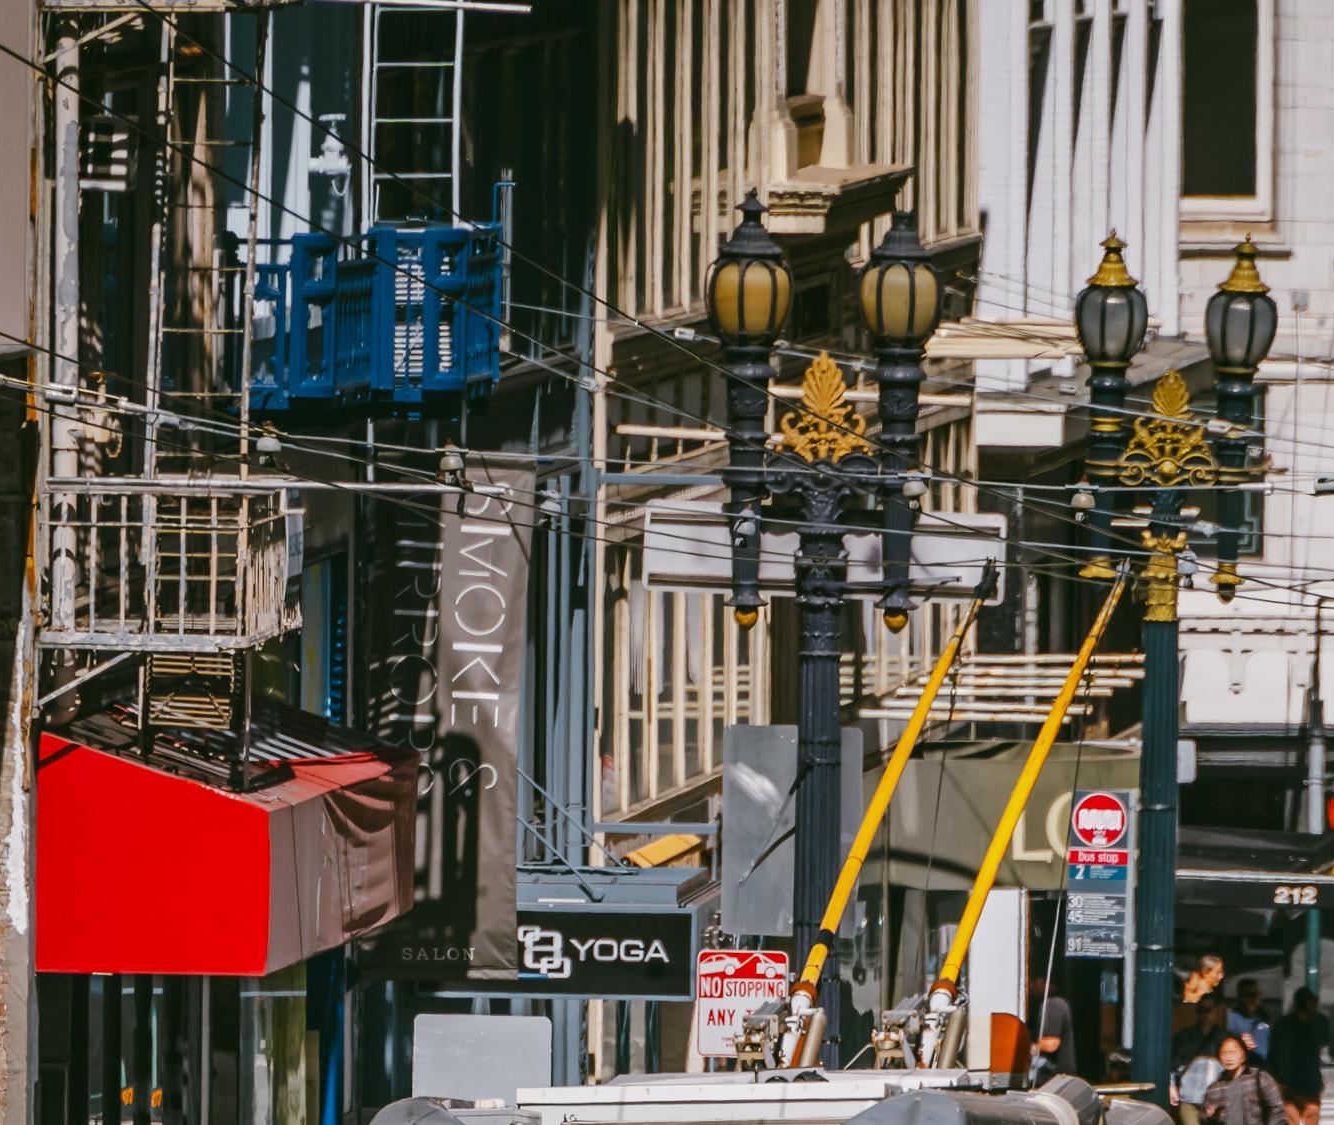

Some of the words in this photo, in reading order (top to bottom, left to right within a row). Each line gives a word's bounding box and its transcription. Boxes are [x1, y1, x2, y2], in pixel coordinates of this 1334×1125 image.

[451, 480, 514, 727] SMOKE
[1078, 851, 1095, 862] bus
[1097, 852, 1120, 865] stop
[1075, 864, 1085, 880] 2
[1068, 895, 1083, 908] 30
[1273, 886, 1318, 905] 212
[1067, 910, 1083, 923] 45
[401, 947, 475, 961] SALON
[569, 938, 670, 963] YOGA
[700, 976, 722, 997] NO
[725, 980, 784, 998] STOPPING
[707, 1007, 736, 1026] ANY
